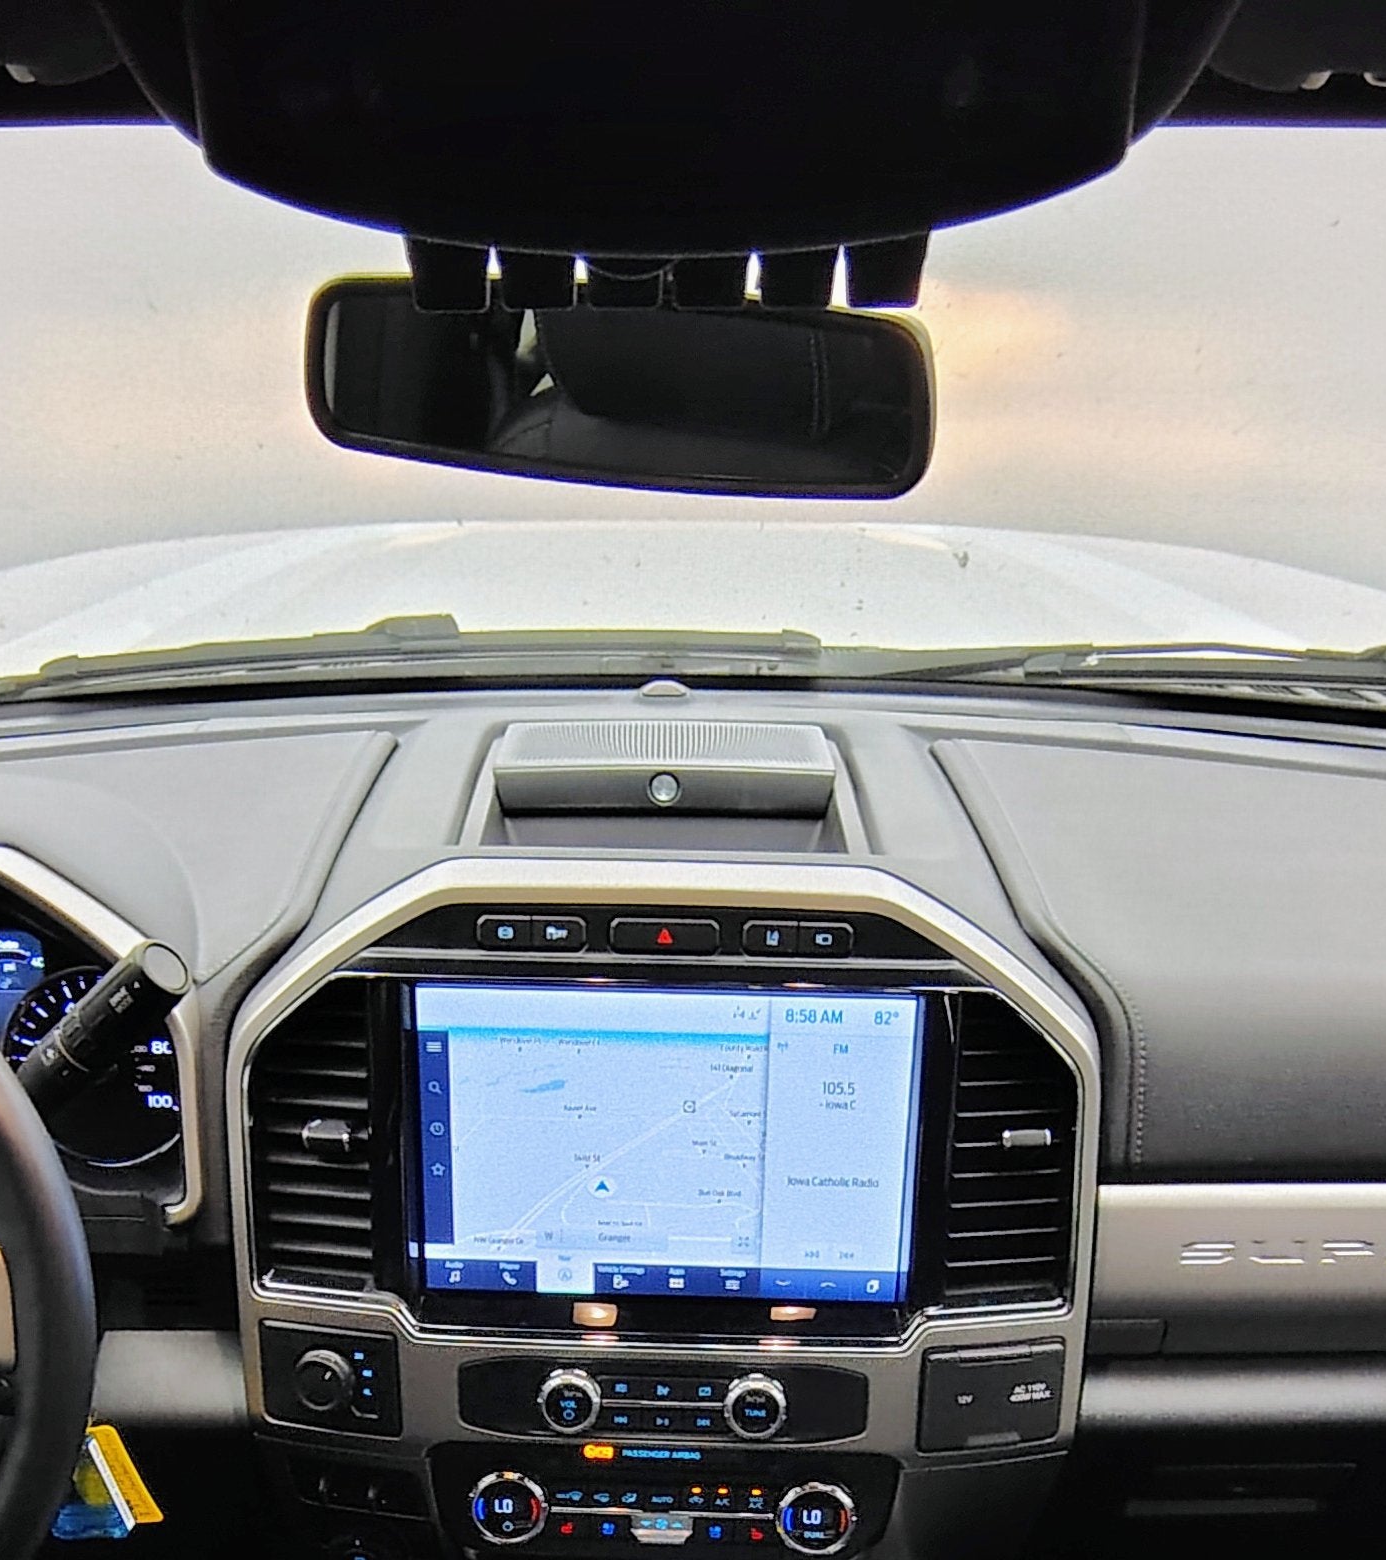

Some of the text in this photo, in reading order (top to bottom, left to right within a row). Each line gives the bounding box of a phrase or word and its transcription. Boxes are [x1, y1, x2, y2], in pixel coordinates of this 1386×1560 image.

[784, 1008, 844, 1025] 8:58 AM
[873, 1010, 900, 1026] 82°
[832, 1043, 850, 1055] FM
[822, 1080, 856, 1096] 105.5
[147, 1094, 174, 1109] 100
[811, 1175, 851, 1188] Catholic
[851, 1176, 880, 1189] Radio
[559, 1400, 578, 1409] VOL
[956, 1394, 974, 1405] 12V
[744, 1408, 767, 1418] TUNE
[621, 1448, 672, 1459] PASSENGER
[671, 1450, 703, 1461] AIRBAG
[494, 1497, 514, 1515] LO
[650, 1496, 675, 1505] AUTO
[802, 1508, 823, 1526] LO
